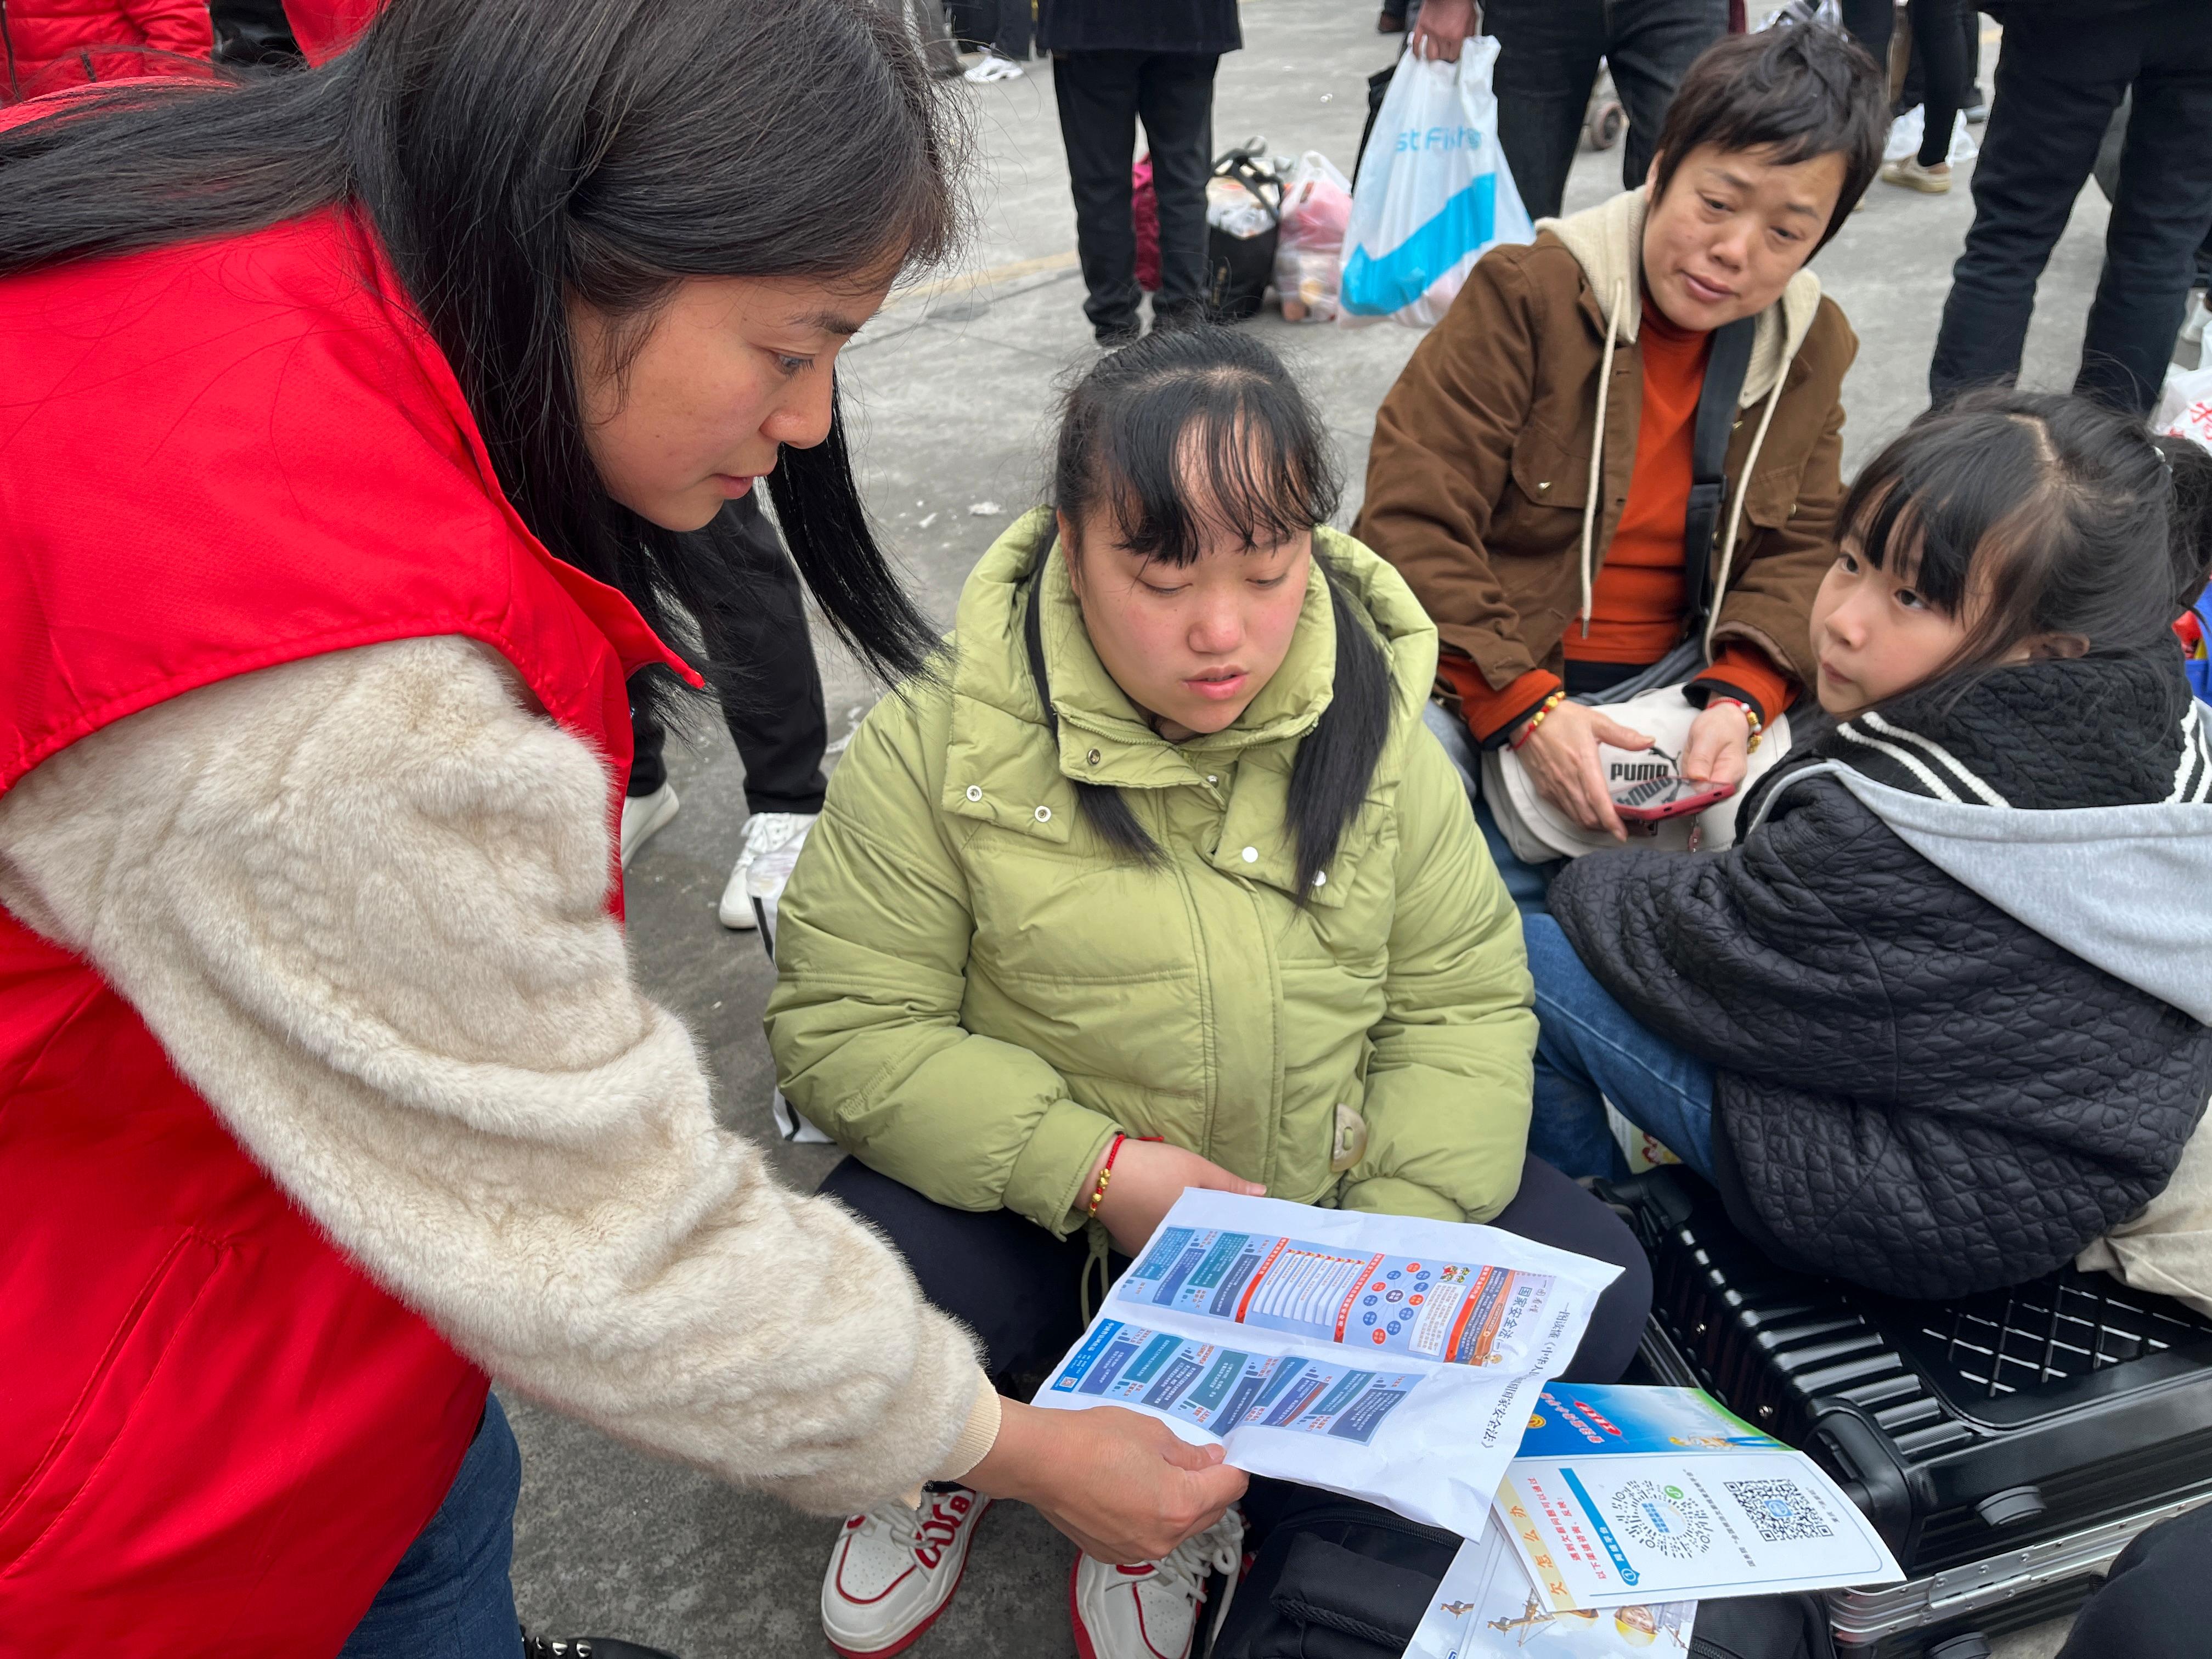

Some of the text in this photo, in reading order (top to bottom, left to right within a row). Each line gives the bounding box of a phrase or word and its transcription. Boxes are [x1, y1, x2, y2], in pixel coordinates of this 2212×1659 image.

[1527, 1477, 1582, 1561] 遇到欠薪问题可以通过
